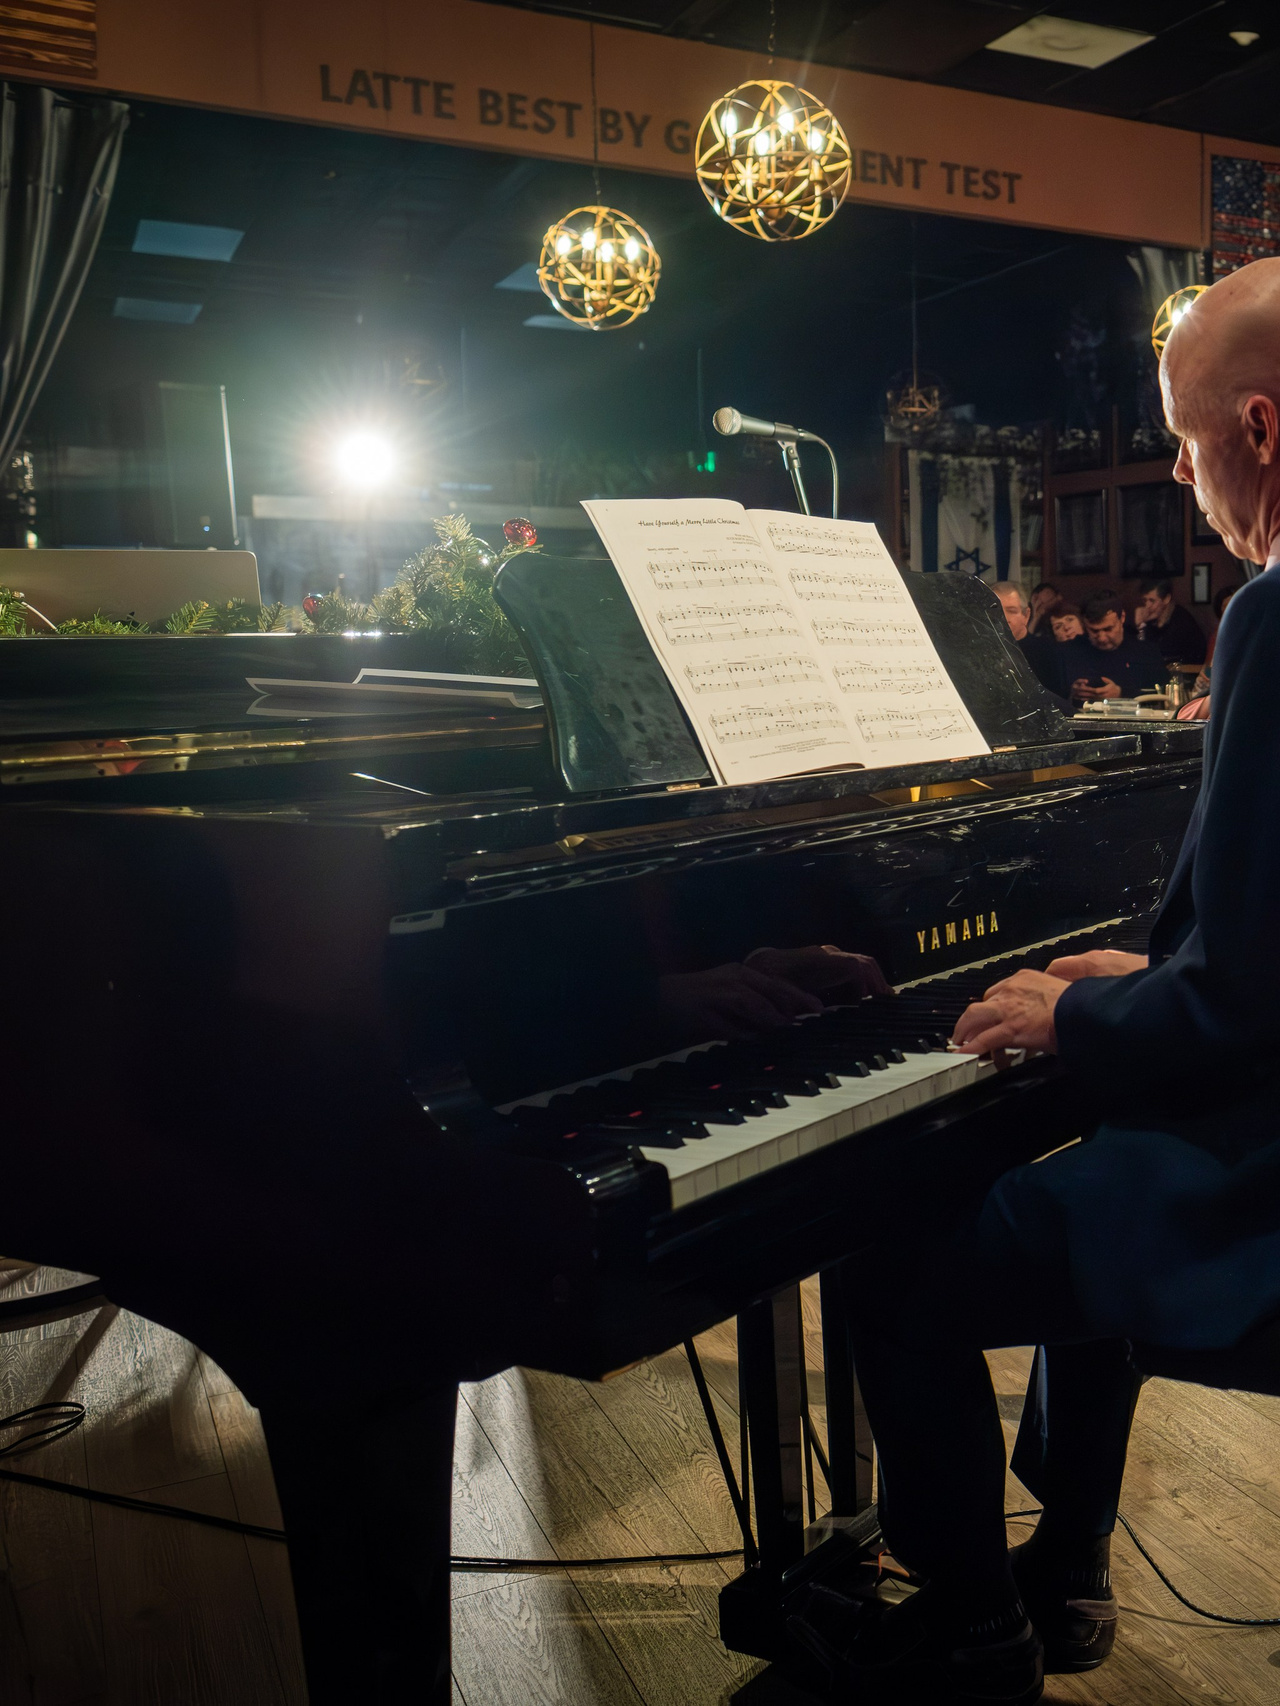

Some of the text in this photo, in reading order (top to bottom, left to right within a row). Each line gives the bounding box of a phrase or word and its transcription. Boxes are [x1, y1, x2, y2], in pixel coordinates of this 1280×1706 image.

[319, 64, 1023, 204] LATTE BEST BY TEST
[916, 910, 999, 954] YAMAHA
